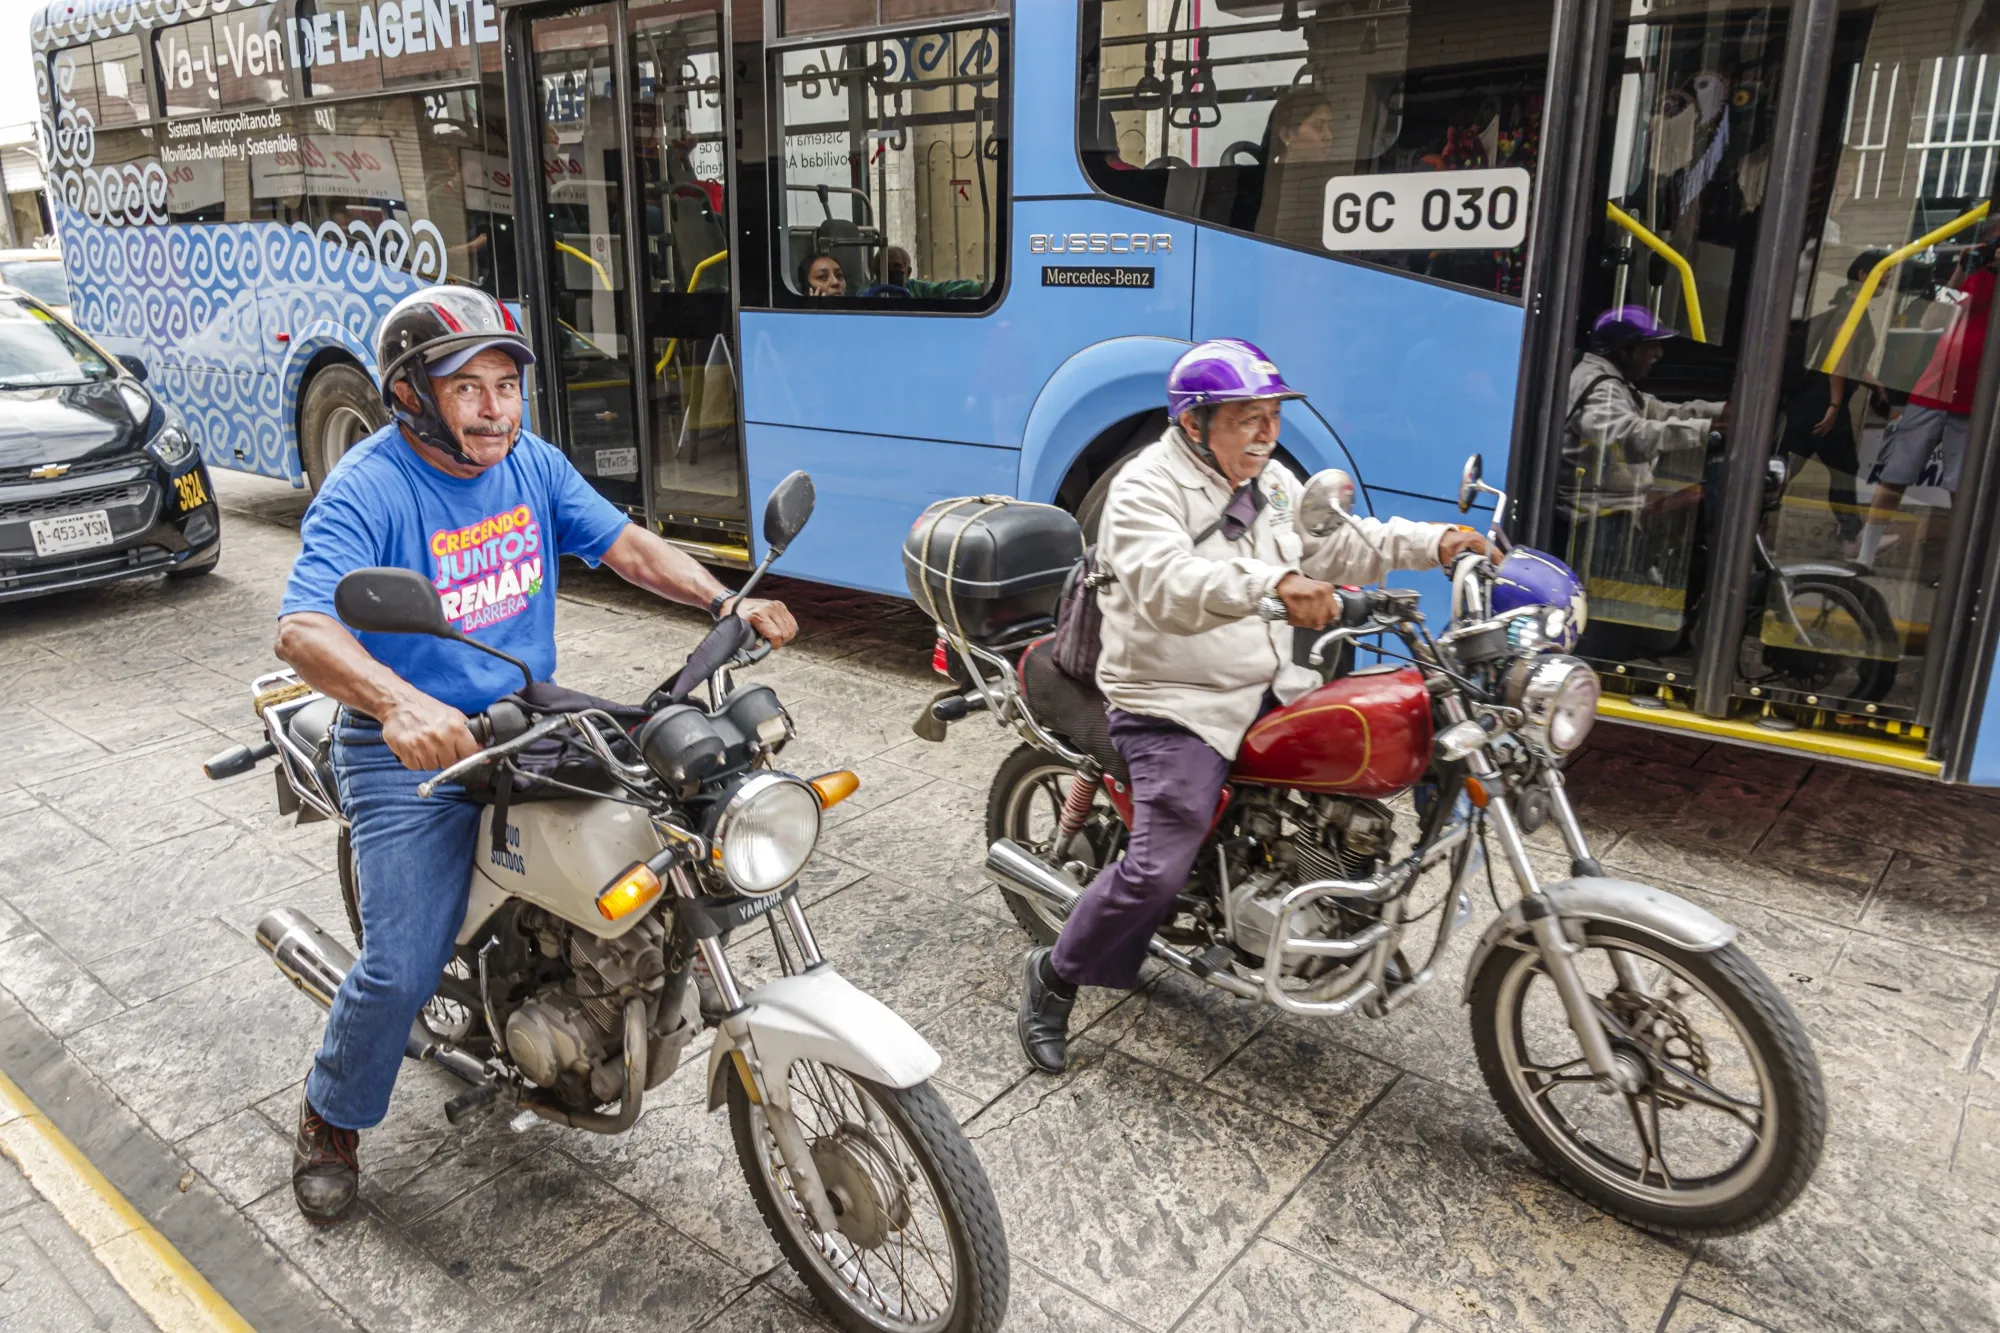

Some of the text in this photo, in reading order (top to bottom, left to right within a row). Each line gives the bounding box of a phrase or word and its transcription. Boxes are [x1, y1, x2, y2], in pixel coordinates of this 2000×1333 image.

[167, 108, 281, 139] Sistema Metropolitano de
[160, 133, 298, 162] Movilidad Amable y Sostenible
[1332, 185, 1519, 235] GC 030
[1029, 233, 1172, 254] BUSSCAR
[1046, 268, 1150, 286] Mercedes-Benz
[173, 470, 208, 512] 3624
[431, 506, 530, 557] CRECENDO
[435, 524, 539, 590] JUNTOS
[440, 557, 543, 621] RENÁN
[464, 595, 527, 631] BARRERA
[738, 891, 783, 921] YAMAHA
